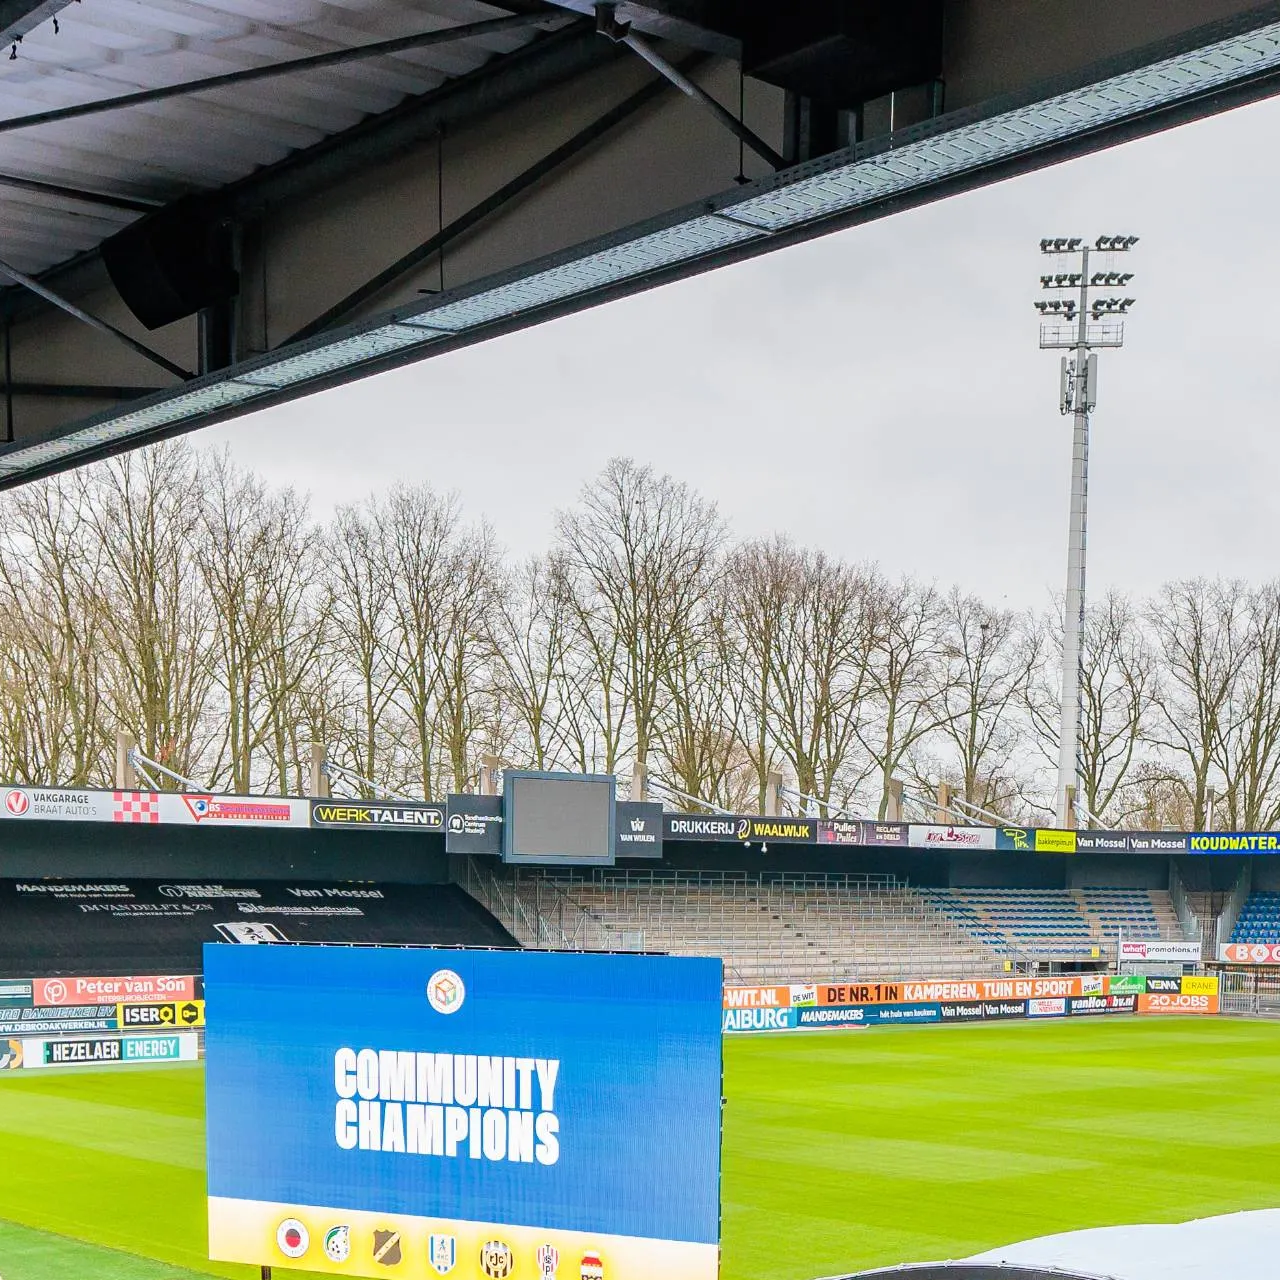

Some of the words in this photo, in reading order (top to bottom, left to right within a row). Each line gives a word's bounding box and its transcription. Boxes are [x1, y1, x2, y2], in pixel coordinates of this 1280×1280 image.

[32, 793, 89, 806] VAKGARAGE
[33, 804, 63, 816] BRAAT
[64, 805, 97, 817] AUTO'S
[670, 819, 735, 836] DRUKKERIJ
[754, 821, 810, 838] WAALWIJK
[1076, 837, 1094, 848] Van
[1094, 837, 1126, 849] Mossel
[1130, 837, 1150, 849] Van
[1151, 837, 1186, 849] Mossel
[15, 884, 131, 893] MANDEMAKERS
[286, 887, 323, 898] Van
[323, 888, 385, 899] Mossel
[76, 979, 122, 995] Peter
[123, 980, 154, 994] van
[154, 976, 186, 992] Son
[827, 987, 848, 1003] DE
[884, 984, 899, 1001] IN
[903, 981, 981, 1001] KAMPEREN,
[983, 981, 1014, 999] TUIN
[1016, 980, 1032, 997] EN
[1034, 978, 1074, 996] SPORT
[1185, 982, 1215, 991] CRANE
[792, 993, 801, 1002] DE
[802, 991, 815, 1001] WIT
[1171, 995, 1209, 1008] JOBS
[21, 1006, 97, 1021] DAKWERKEN
[800, 1007, 865, 1022] MANDEMAKERS
[941, 1005, 956, 1017] Van
[956, 1004, 982, 1016] Mossel
[985, 1003, 1000, 1015] Van
[1000, 1002, 1025, 1014] Mossel
[52, 1038, 120, 1061] HEZELAER
[126, 1036, 178, 1058] ENERGY
[333, 1046, 561, 1112] COMMUNITY
[333, 1098, 561, 1166] CHAMPIONS
